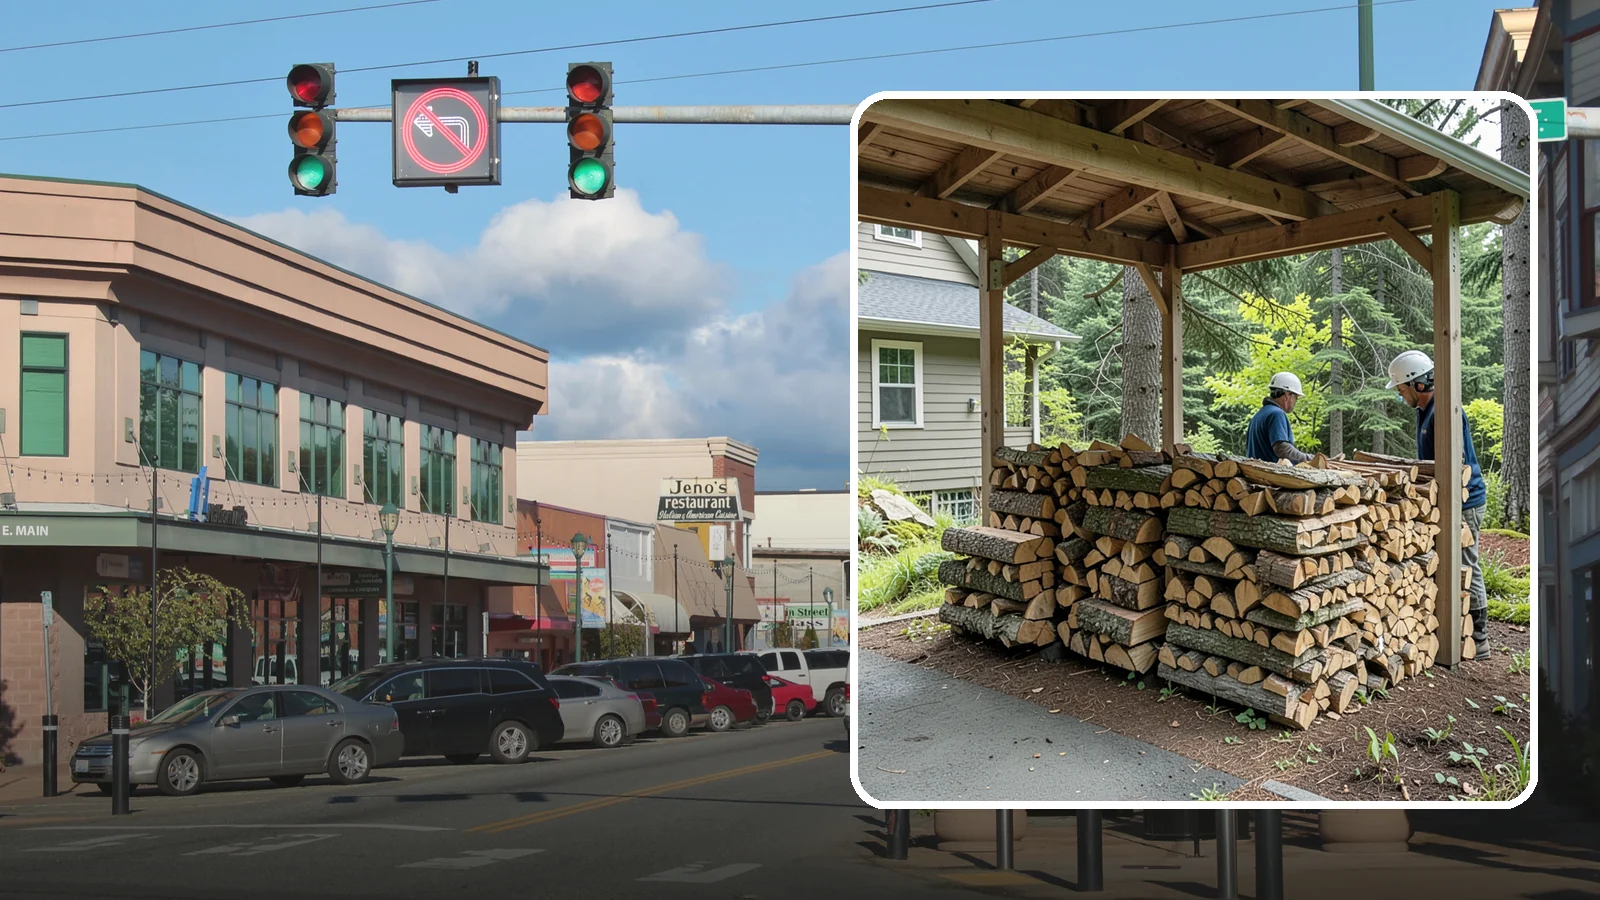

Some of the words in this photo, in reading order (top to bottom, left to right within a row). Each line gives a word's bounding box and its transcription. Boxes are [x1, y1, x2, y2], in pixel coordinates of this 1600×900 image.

[670, 480, 727, 494] Jeno's
[665, 497, 731, 509] restaurant
[659, 510, 681, 519] Italian
[686, 509, 714, 519] American
[715, 509, 737, 519] Cuisine
[2, 525, 13, 536] E.
[15, 525, 49, 536] MAIN
[797, 607, 828, 616] Street
[790, 618, 823, 626] lass
